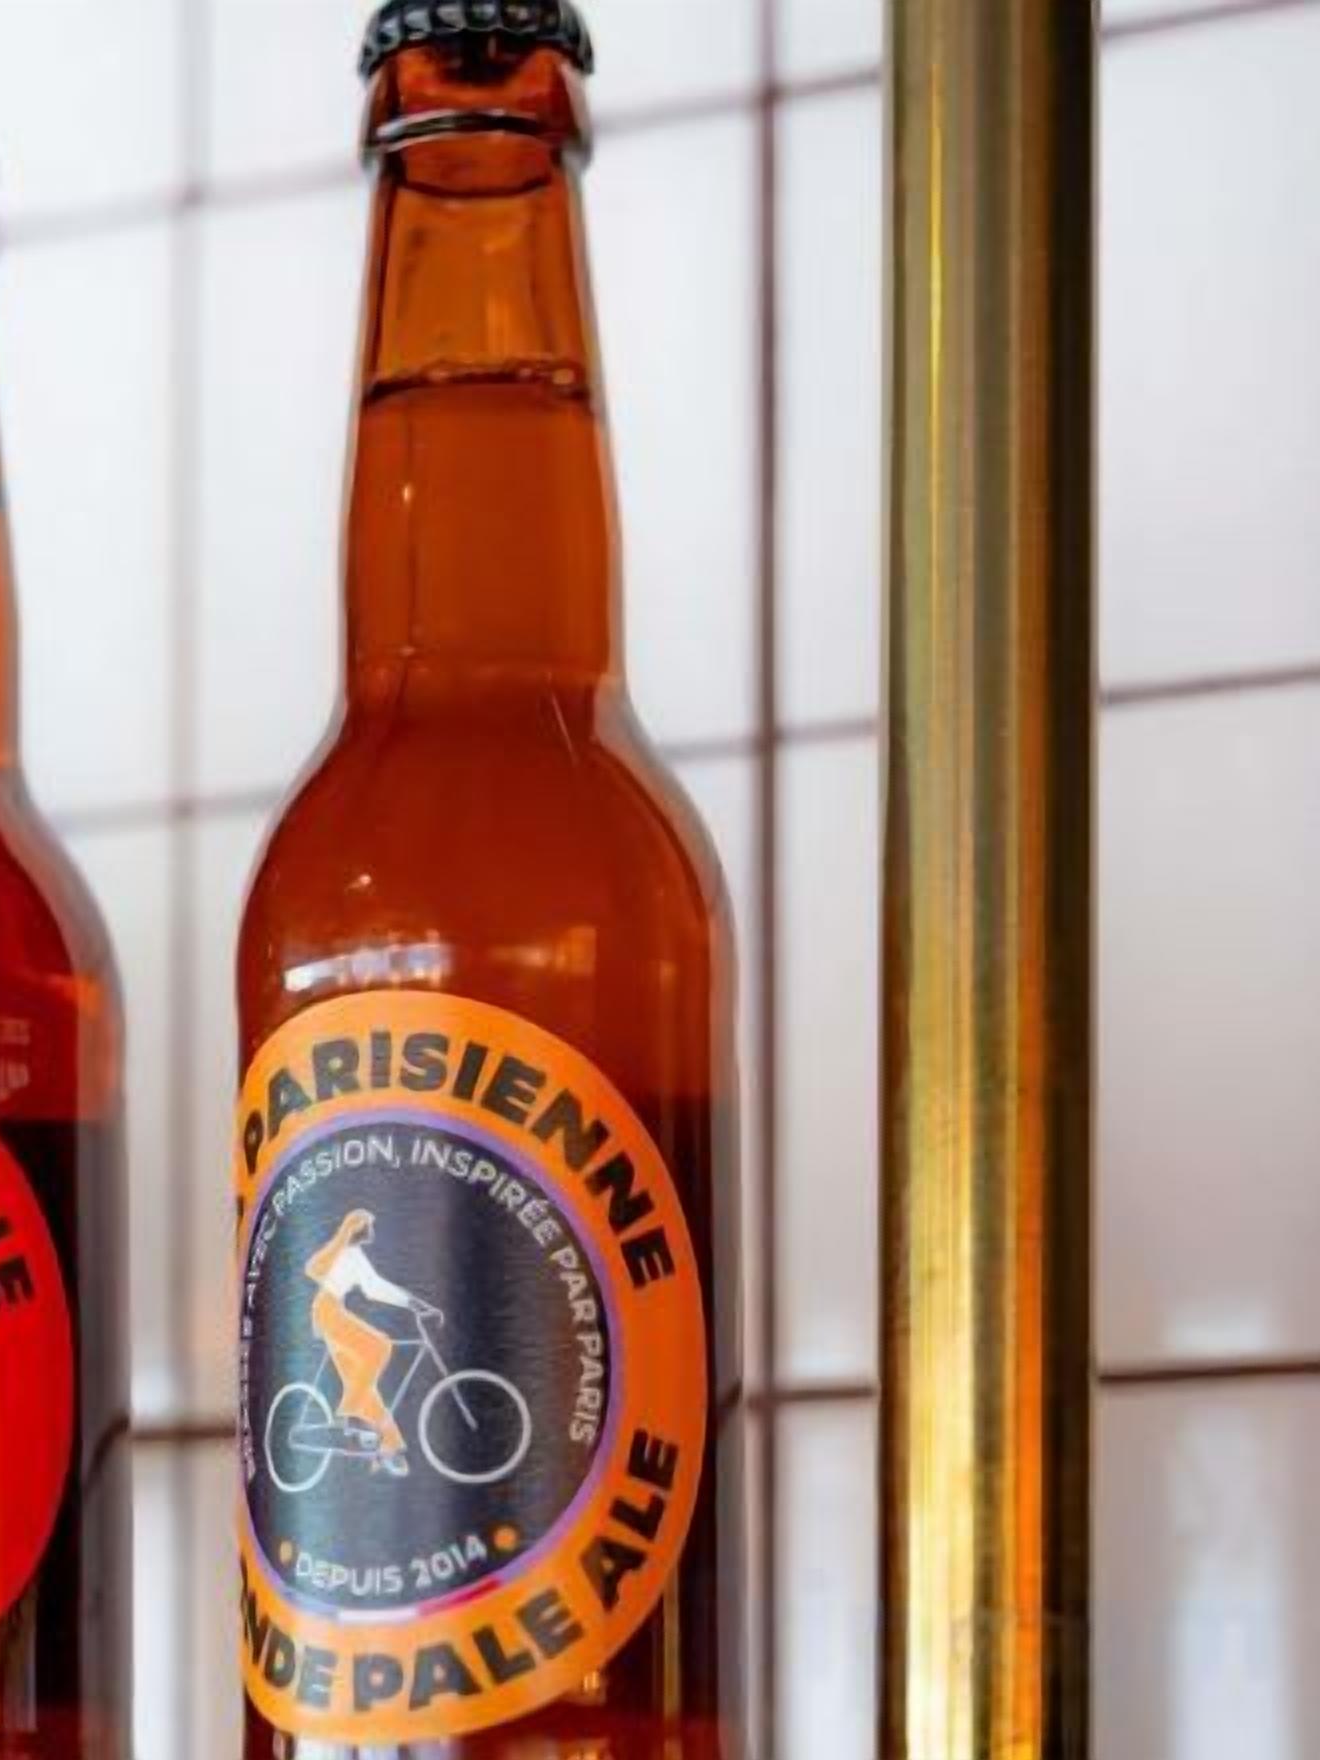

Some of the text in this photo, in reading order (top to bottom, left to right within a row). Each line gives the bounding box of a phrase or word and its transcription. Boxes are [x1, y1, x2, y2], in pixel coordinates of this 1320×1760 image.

[243, 1030, 677, 1290] PARISIENNE
[549, 1245, 598, 1325] PAR
[569, 1330, 605, 1443] PARIS
[294, 1533, 490, 1597] DEPUIS 2014
[351, 1586, 586, 1713] PALE
[580, 1428, 679, 1612] ALE
